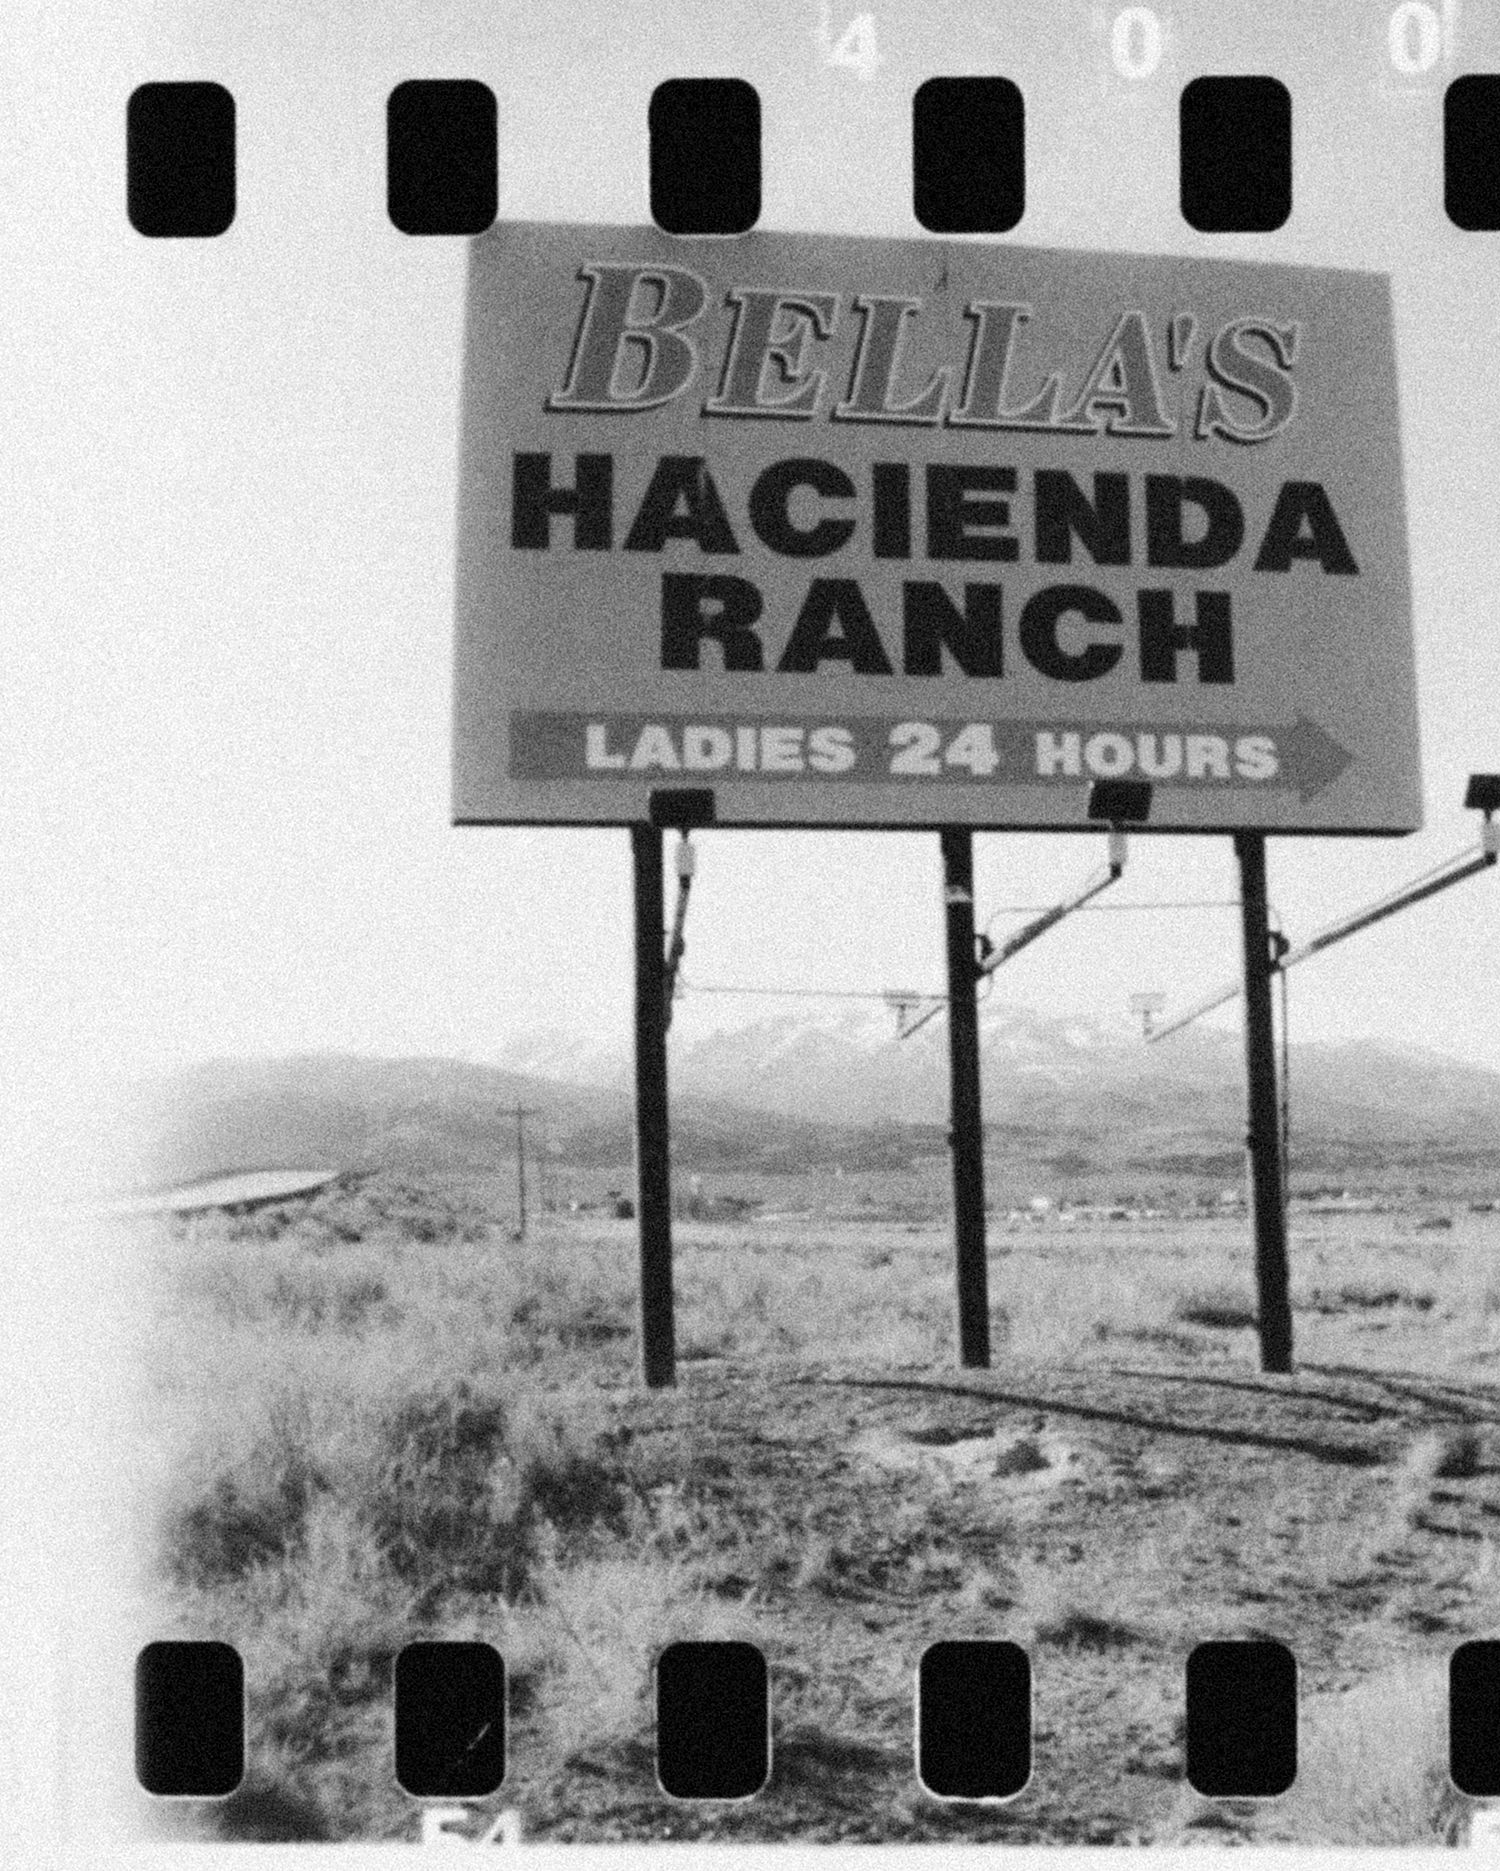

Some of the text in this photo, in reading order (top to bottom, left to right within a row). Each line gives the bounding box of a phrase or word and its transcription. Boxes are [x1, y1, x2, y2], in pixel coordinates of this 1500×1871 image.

[543, 260, 1303, 445] BELLA'S
[510, 450, 1360, 576] HACIENDA
[660, 572, 1235, 685] RANCH
[584, 721, 1279, 779] LADIES 24 HOURS
